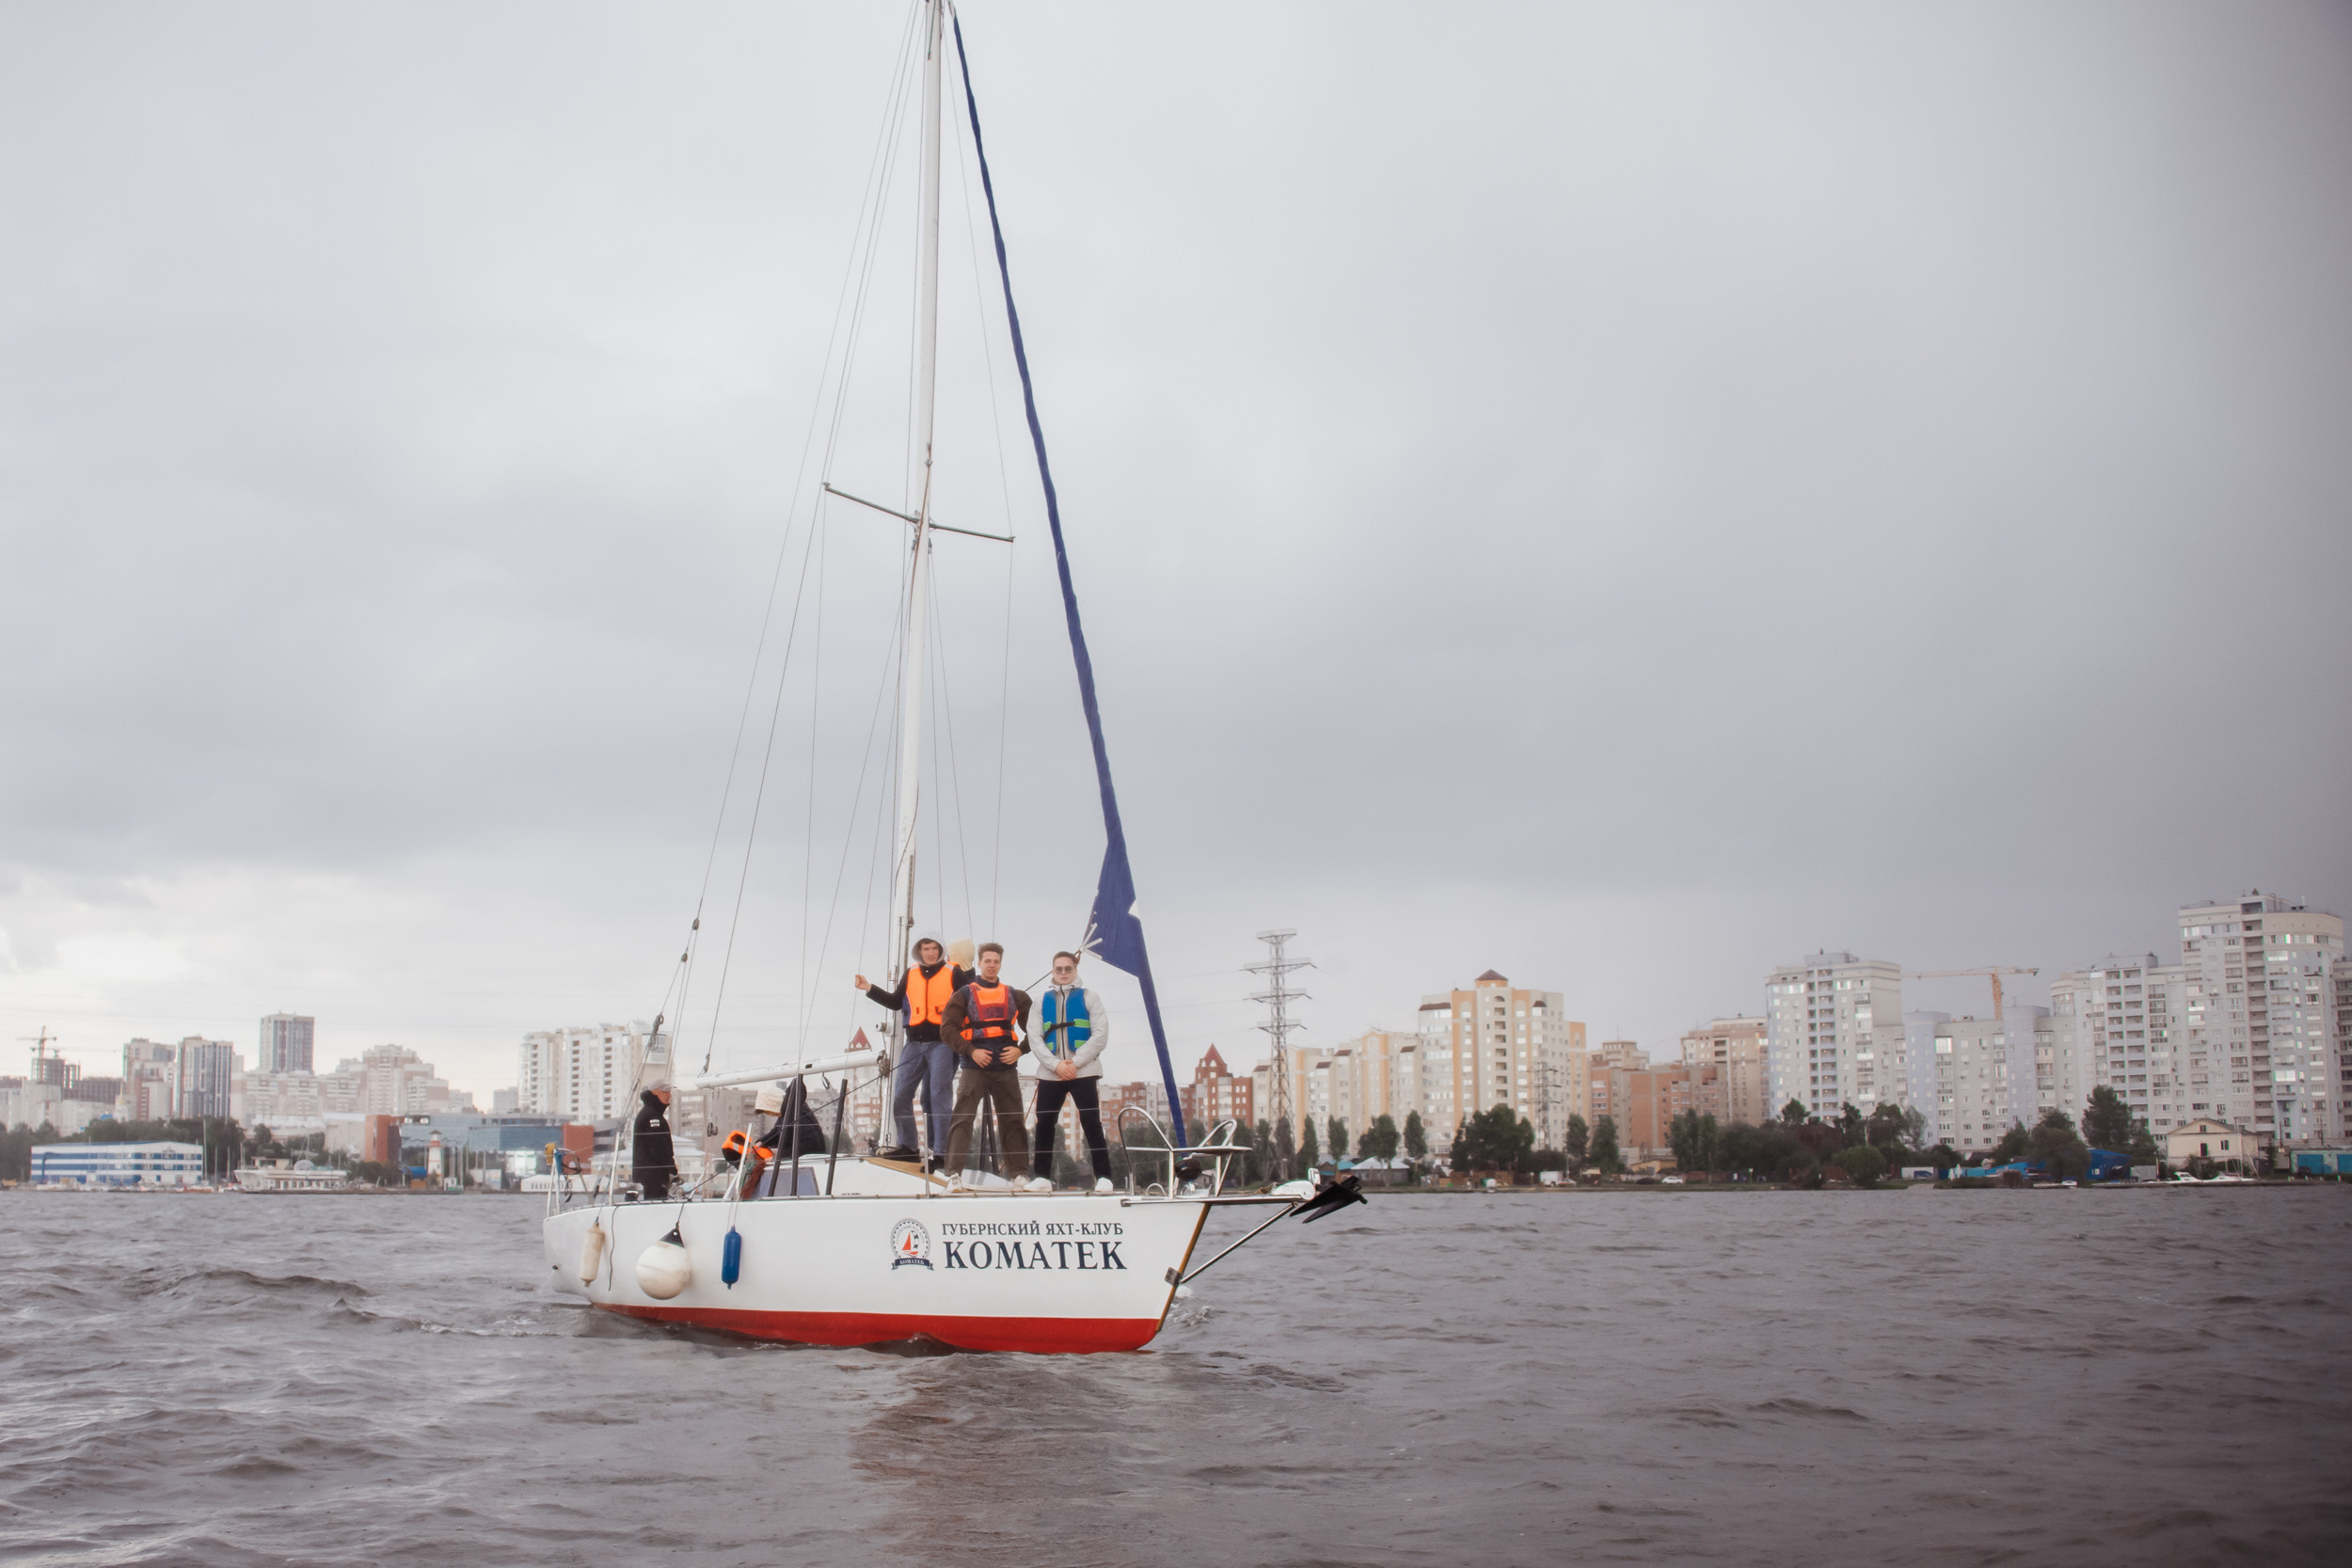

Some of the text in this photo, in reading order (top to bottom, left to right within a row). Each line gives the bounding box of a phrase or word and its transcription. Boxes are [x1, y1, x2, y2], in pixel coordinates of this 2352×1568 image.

[942, 1220, 1041, 1236] ГУБЕРНСКИЙ
[1045, 1223, 1123, 1235] ЯХТ-КЛУБ
[943, 1241, 1128, 1270] КОМАТЕК
